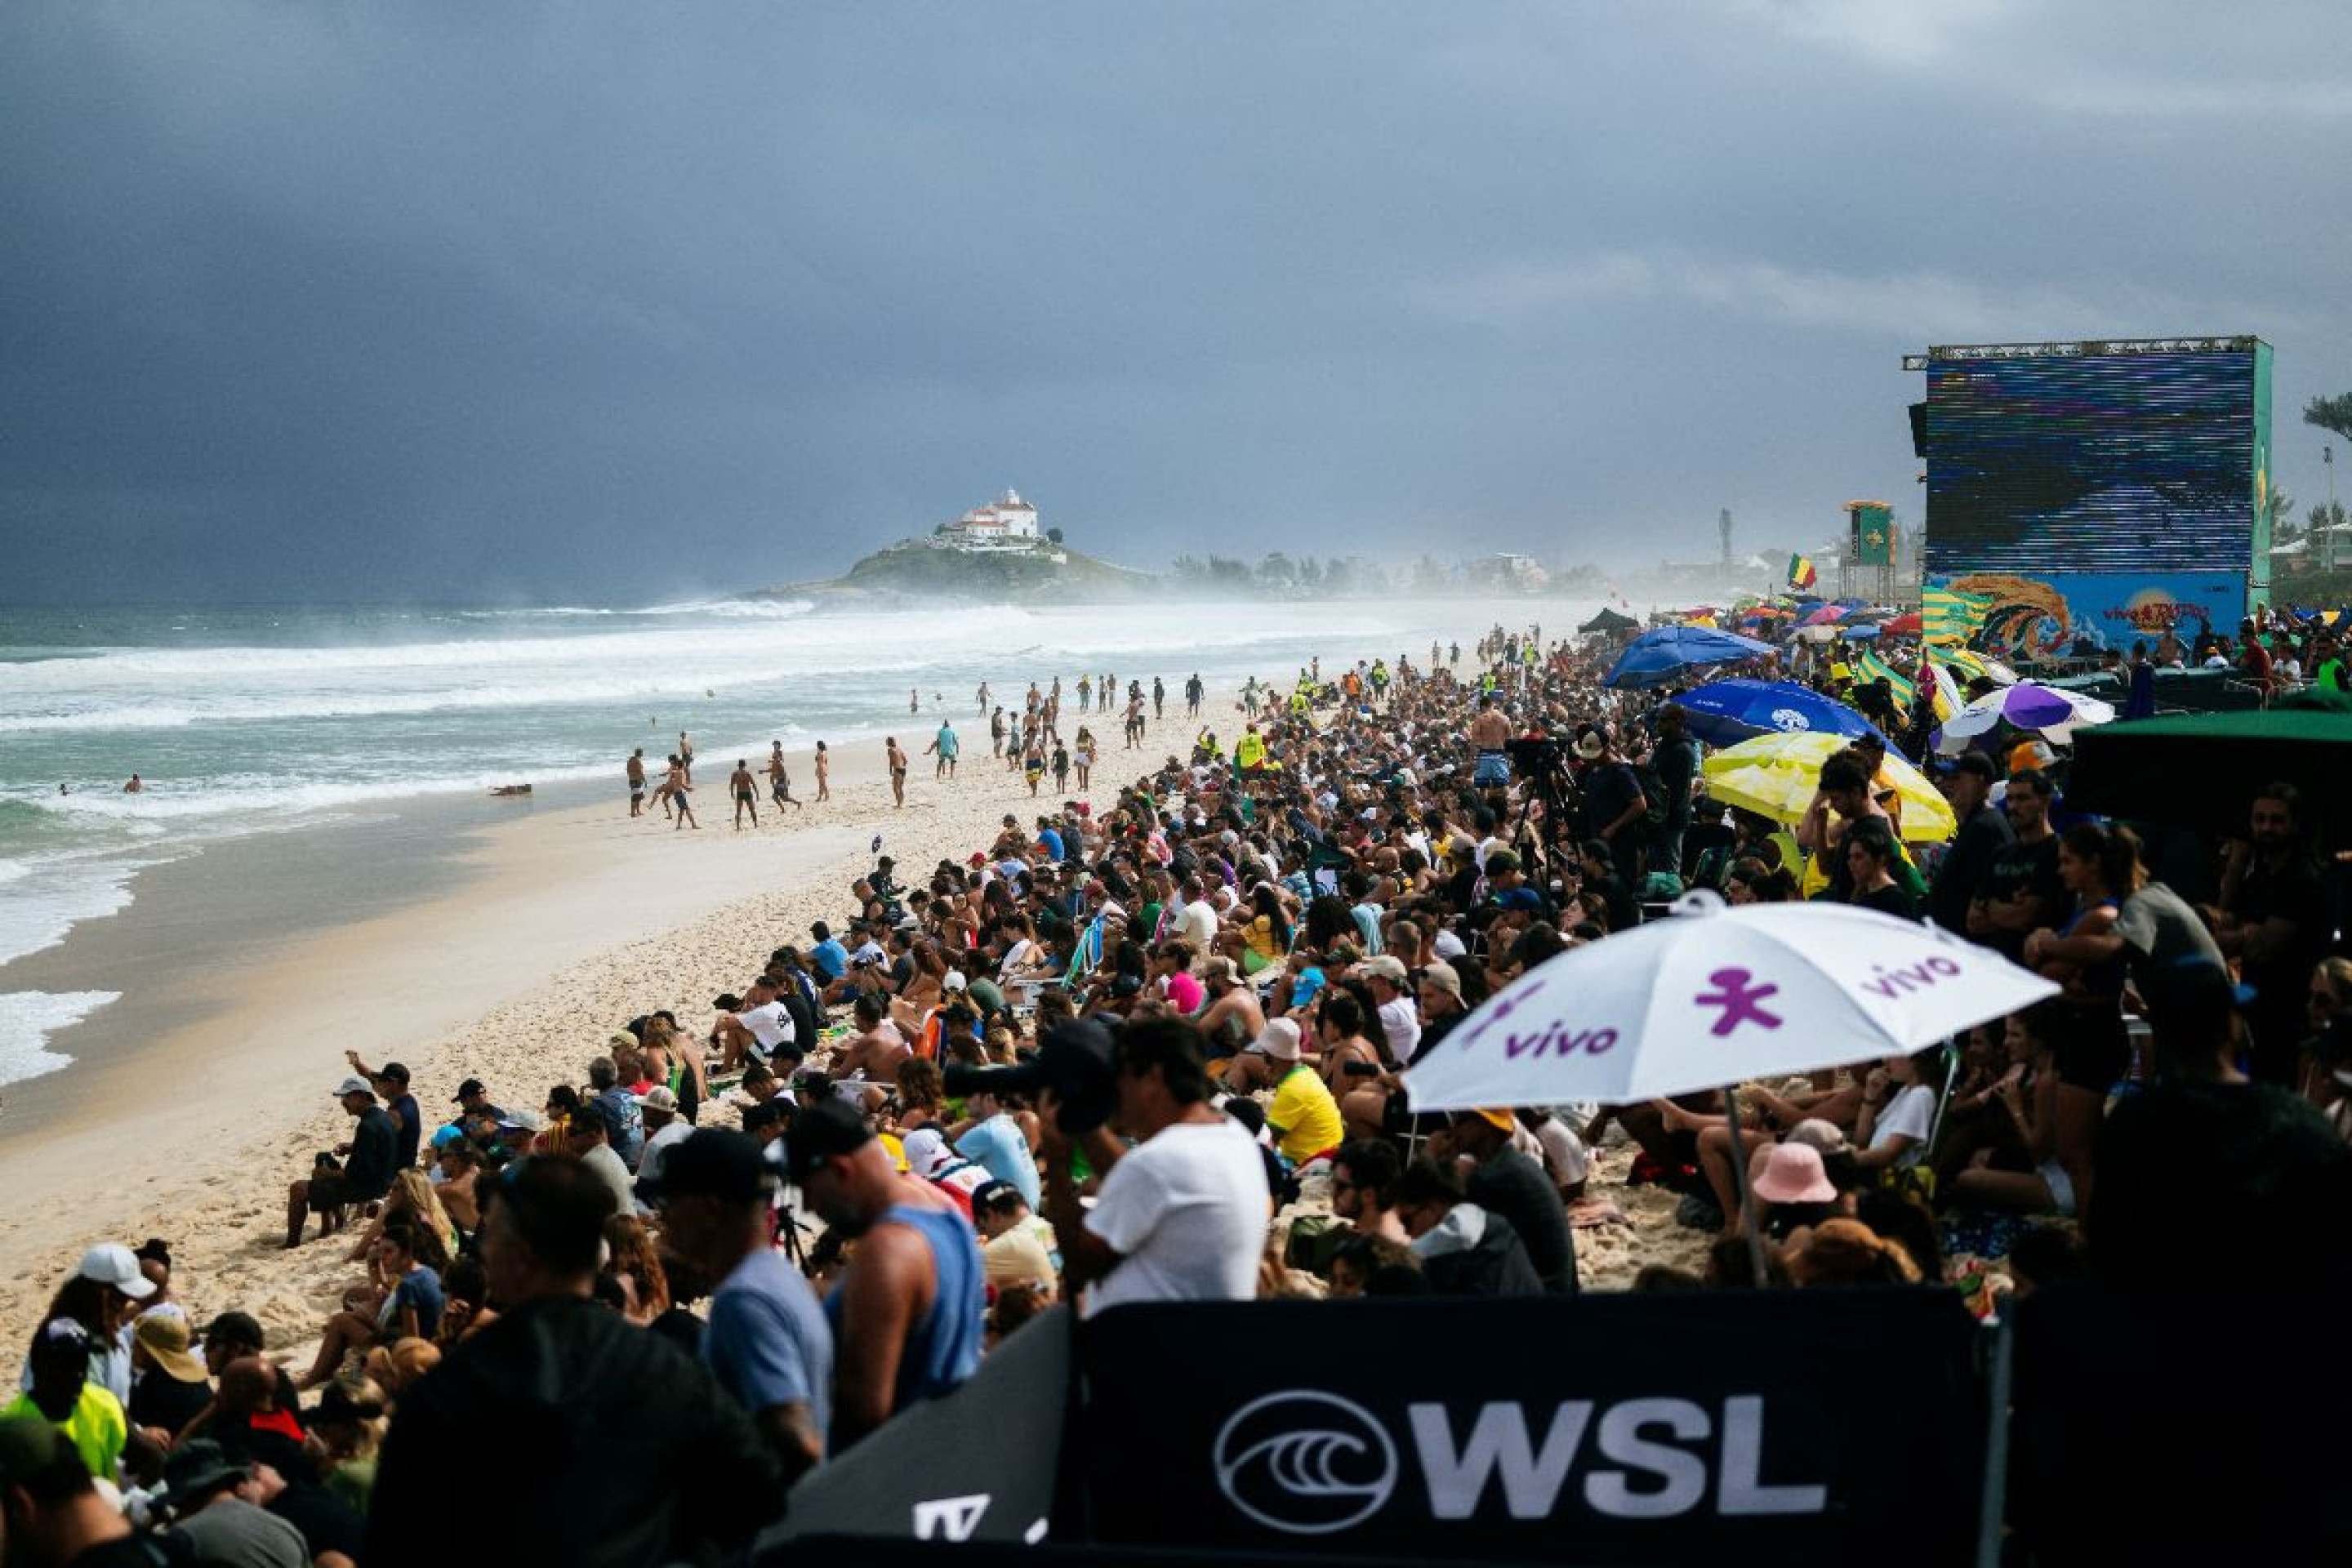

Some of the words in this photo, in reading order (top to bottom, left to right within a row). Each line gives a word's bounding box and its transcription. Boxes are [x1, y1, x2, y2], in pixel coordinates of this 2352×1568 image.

[1860, 956, 1961, 1000] vivo
[1506, 1020, 1618, 1058] vivo
[1408, 1395, 1825, 1519] WSL
